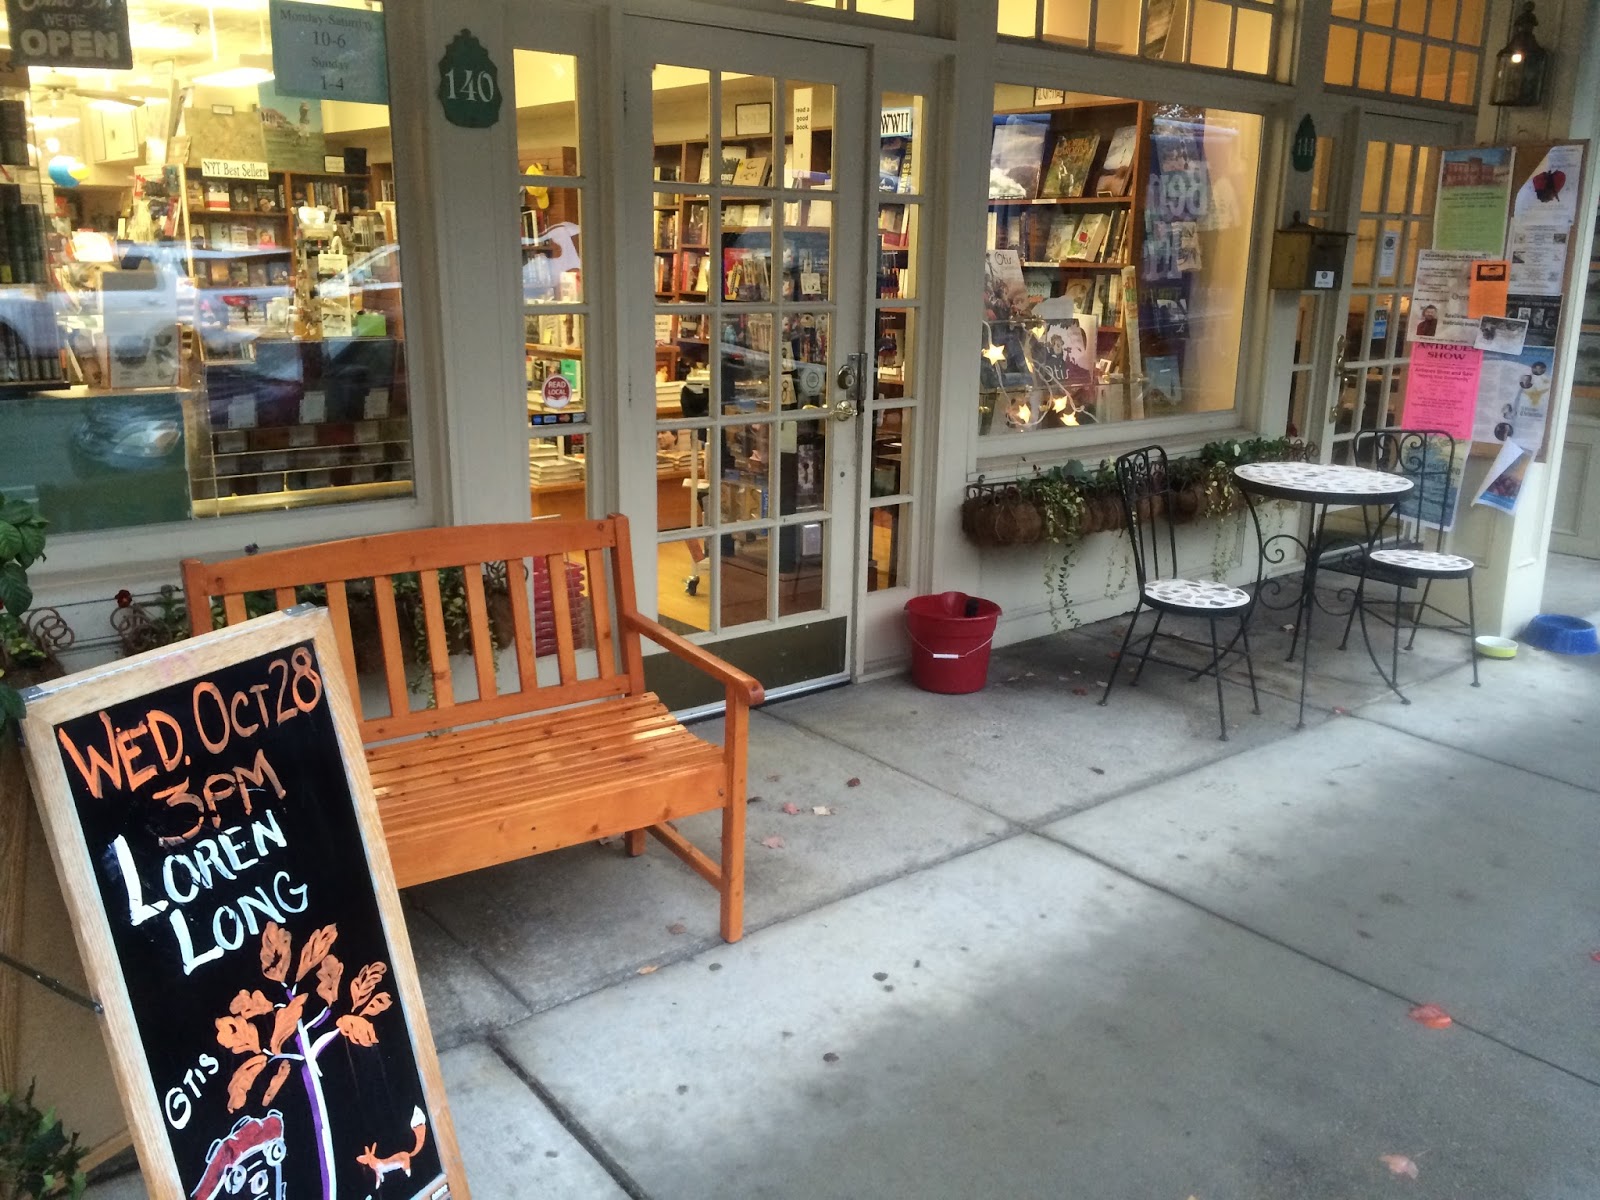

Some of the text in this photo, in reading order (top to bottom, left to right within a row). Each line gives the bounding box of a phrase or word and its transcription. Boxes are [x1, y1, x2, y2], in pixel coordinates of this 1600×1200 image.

[42, 12, 88, 28] WE'RE
[20, 28, 119, 59] OPEN
[312, 31, 346, 48] 10-6
[311, 57, 350, 71] Sunday
[320, 75, 344, 91] 1-4
[445, 68, 494, 103] 140
[880, 112, 909, 134] WWII
[203, 161, 268, 179] NYT Best Sellers
[900, 162, 910, 194] JAMES
[995, 252, 1012, 266] Otis
[1427, 351, 1466, 360] SHOW
[1044, 364, 1070, 383] Otis
[548, 381, 567, 389] READ
[268, 646, 322, 727] 28
[111, 808, 288, 926] LOREN
[169, 870, 309, 976] LONG
